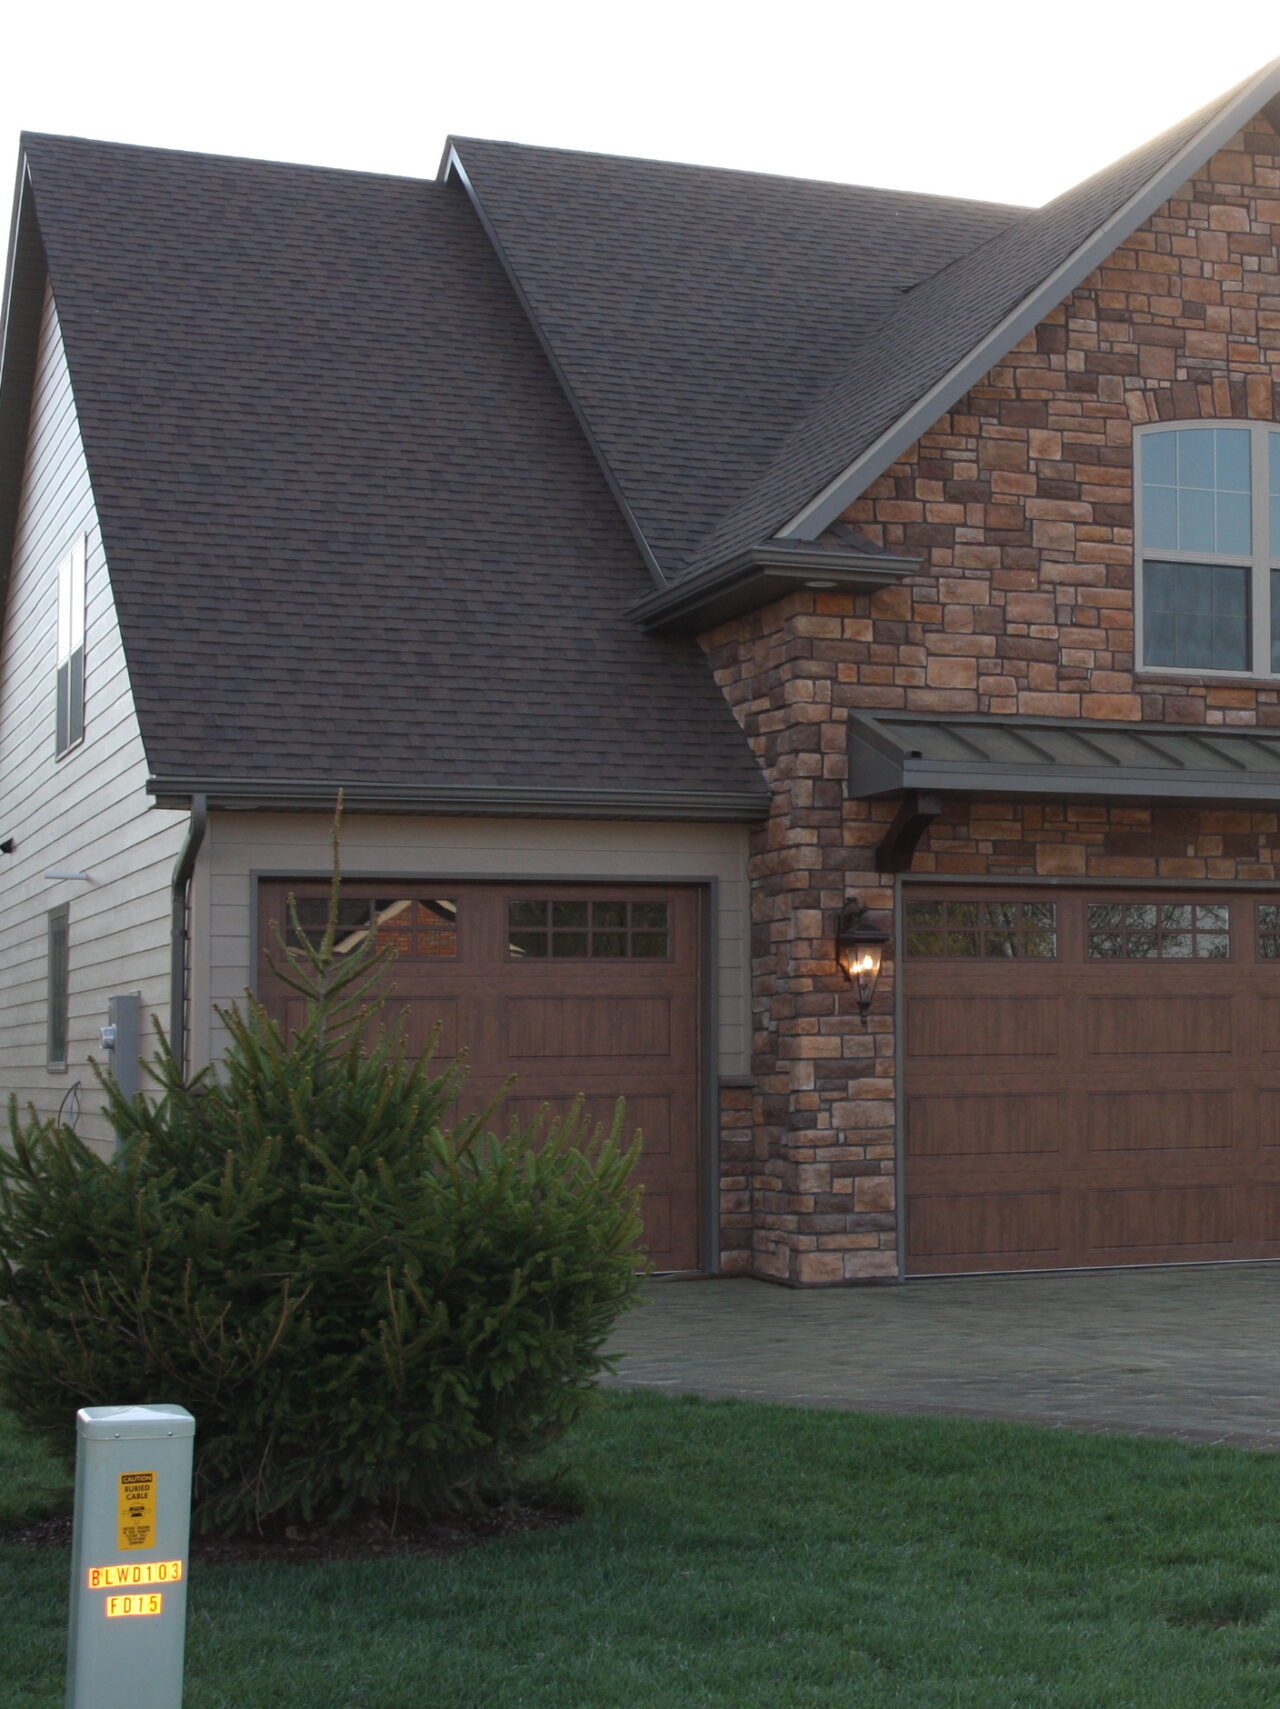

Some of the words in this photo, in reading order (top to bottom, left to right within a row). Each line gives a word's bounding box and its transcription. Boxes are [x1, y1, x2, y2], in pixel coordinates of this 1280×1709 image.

[123, 1474, 152, 1483] CAUTION
[124, 1484, 151, 1493] BURIED
[126, 1492, 149, 1500] CABLE
[92, 1563, 179, 1586] BLWD103
[111, 1596, 158, 1614] FD15
